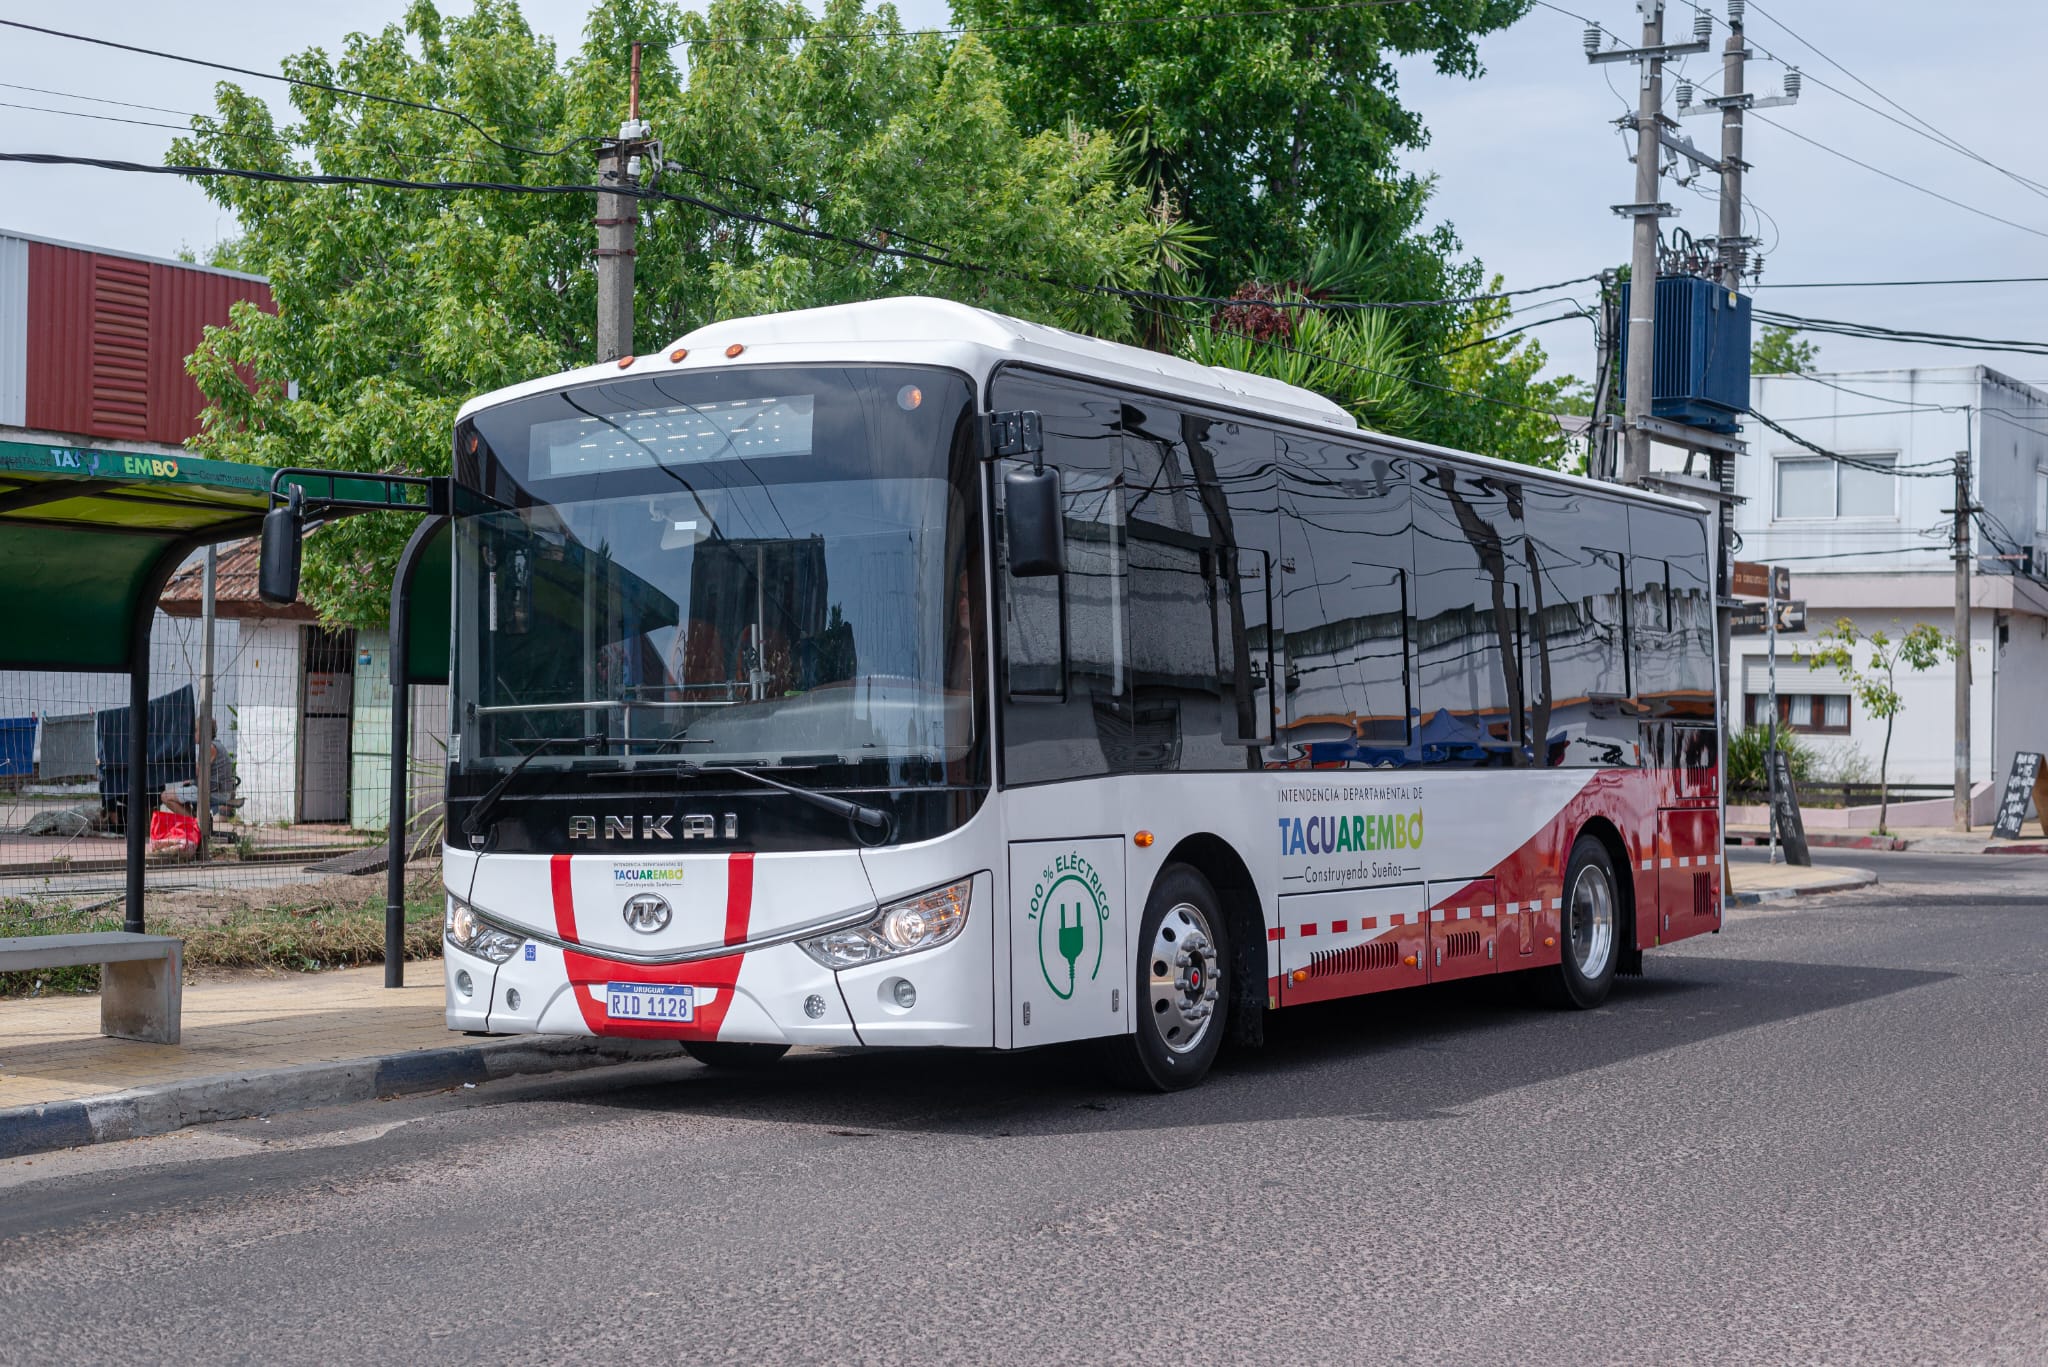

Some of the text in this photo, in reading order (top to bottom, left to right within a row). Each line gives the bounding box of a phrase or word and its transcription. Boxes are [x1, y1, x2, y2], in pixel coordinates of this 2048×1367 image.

[1278, 787, 1423, 803] INTENDENCIA DEPARTAMENTAL DE
[569, 813, 738, 839] ANKAI
[1028, 850, 1110, 920] 100 % ELÉCTRICO
[1304, 860, 1402, 886] Construyendo Sueños
[633, 985, 665, 994] URUGUAY
[612, 994, 688, 1018] RID 1128
